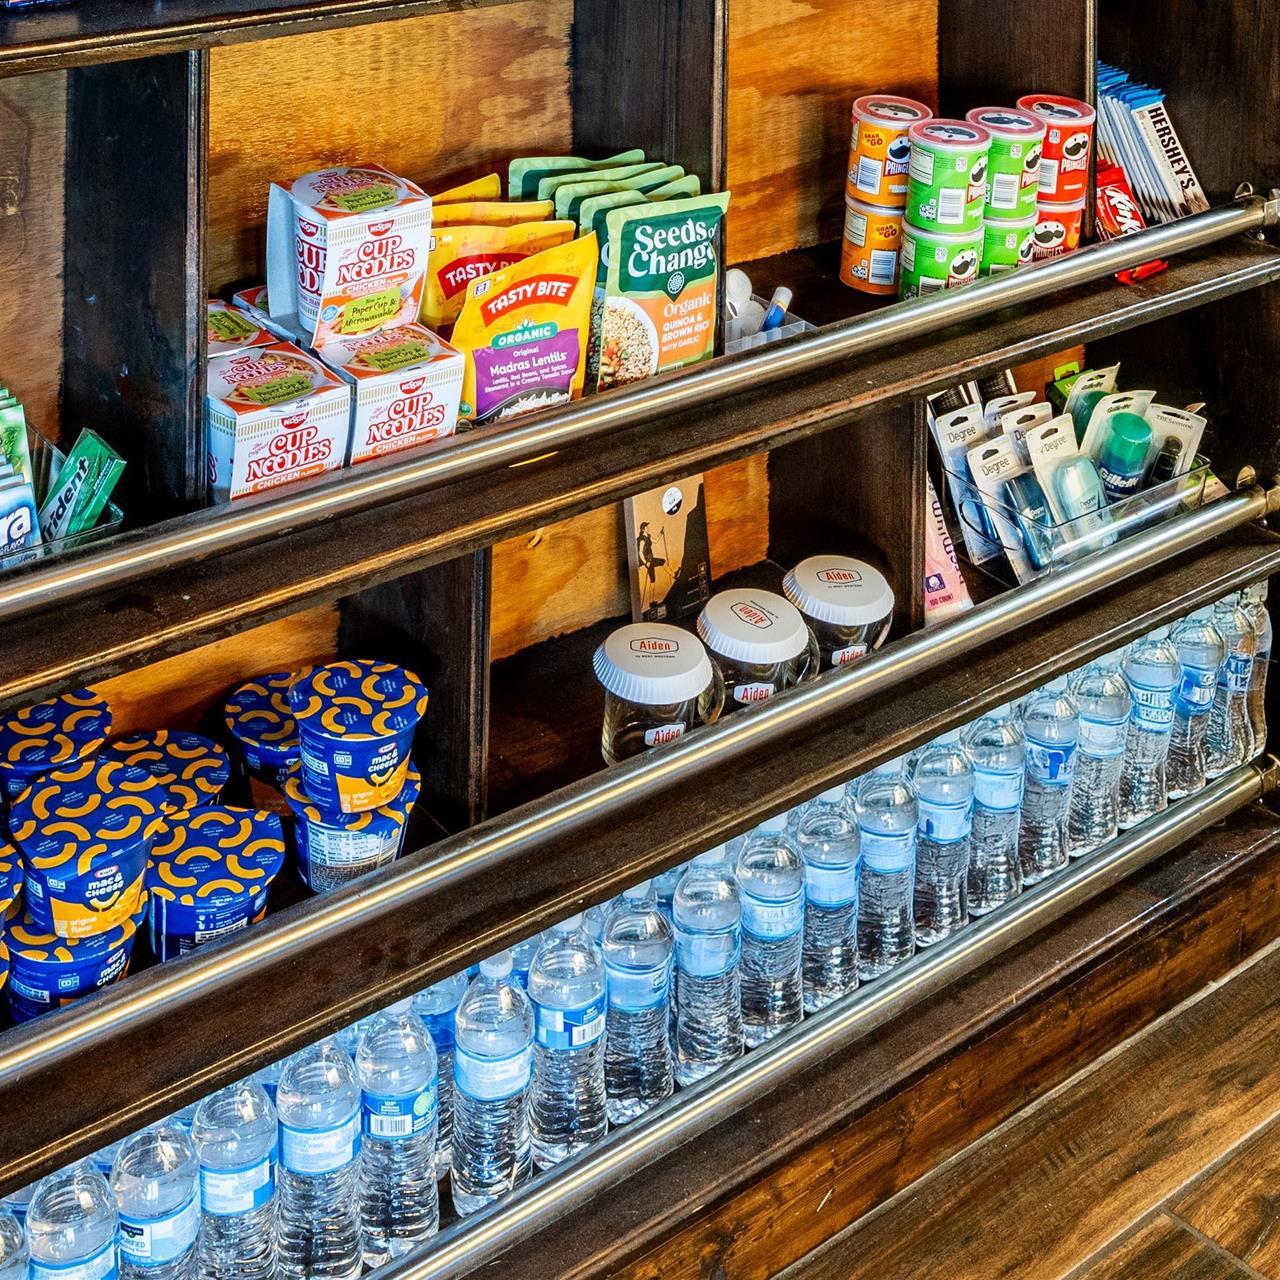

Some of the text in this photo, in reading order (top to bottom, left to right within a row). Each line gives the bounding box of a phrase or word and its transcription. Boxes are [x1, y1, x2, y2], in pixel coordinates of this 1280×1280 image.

[1147, 105, 1196, 190] HERSHEY'S
[885, 161, 909, 175] PRING
[1061, 160, 1087, 173] PRINGLES
[370, 222, 393, 233] NISSIN
[634, 218, 708, 253] Seeds
[357, 235, 402, 262] CUP
[336, 248, 415, 287] NOODLES
[346, 278, 386, 293] CHICKEN
[351, 298, 397, 316] Paper Cup &
[487, 281, 570, 315] TASTY BITE
[664, 292, 712, 318] Organic
[343, 308, 394, 328] Microwavable
[663, 313, 703, 331] QUINOA &
[498, 326, 551, 346] ORGANIC
[662, 328, 693, 342] BROWN
[662, 336, 700, 352] WITH GARLIC
[512, 346, 539, 358] Original
[490, 352, 567, 377] Madras Lentils
[401, 380, 425, 391] NISSIN
[388, 392, 433, 419] CUP
[283, 414, 307, 426] NISSIN
[366, 406, 445, 445] NOODLES
[270, 426, 319, 456] CUP
[948, 425, 977, 443] Degree
[375, 436, 417, 453] CHICKEN
[1045, 435, 1067, 452] Degree
[246, 439, 332, 482] NOODLES
[981, 458, 1010, 476] Degree
[257, 471, 301, 489] CHICKEN
[42, 456, 90, 543] Trident
[825, 572, 854, 581] Aiden
[738, 605, 767, 624] Aiden
[639, 640, 671, 651] Aiden
[741, 687, 769, 701] Aiden
[653, 729, 680, 744] Aiden
